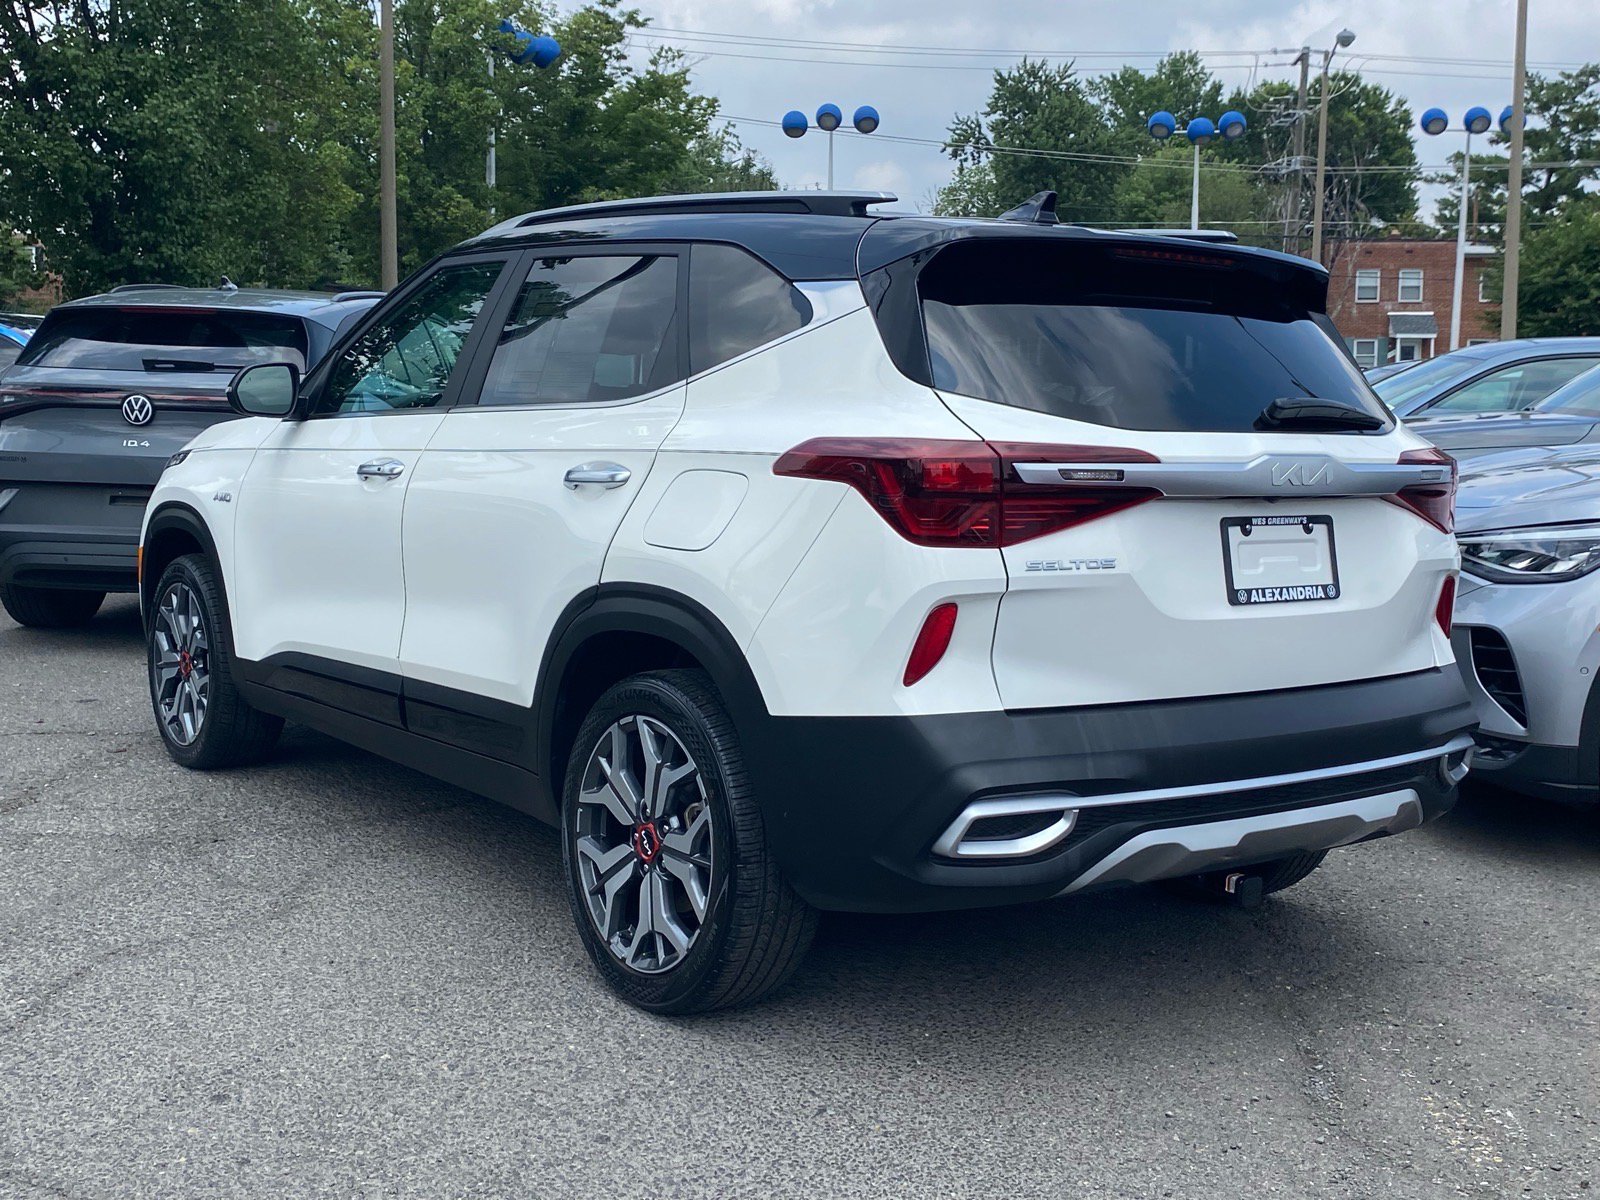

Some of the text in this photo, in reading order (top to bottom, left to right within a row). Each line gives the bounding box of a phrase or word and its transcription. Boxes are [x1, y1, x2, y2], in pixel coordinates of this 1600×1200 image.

[1271, 462, 1334, 486] KIA
[1267, 517, 1307, 525] GREENWAY'S
[1025, 558, 1116, 572] SELTOS
[1250, 586, 1325, 602] ALEXANDRIA
